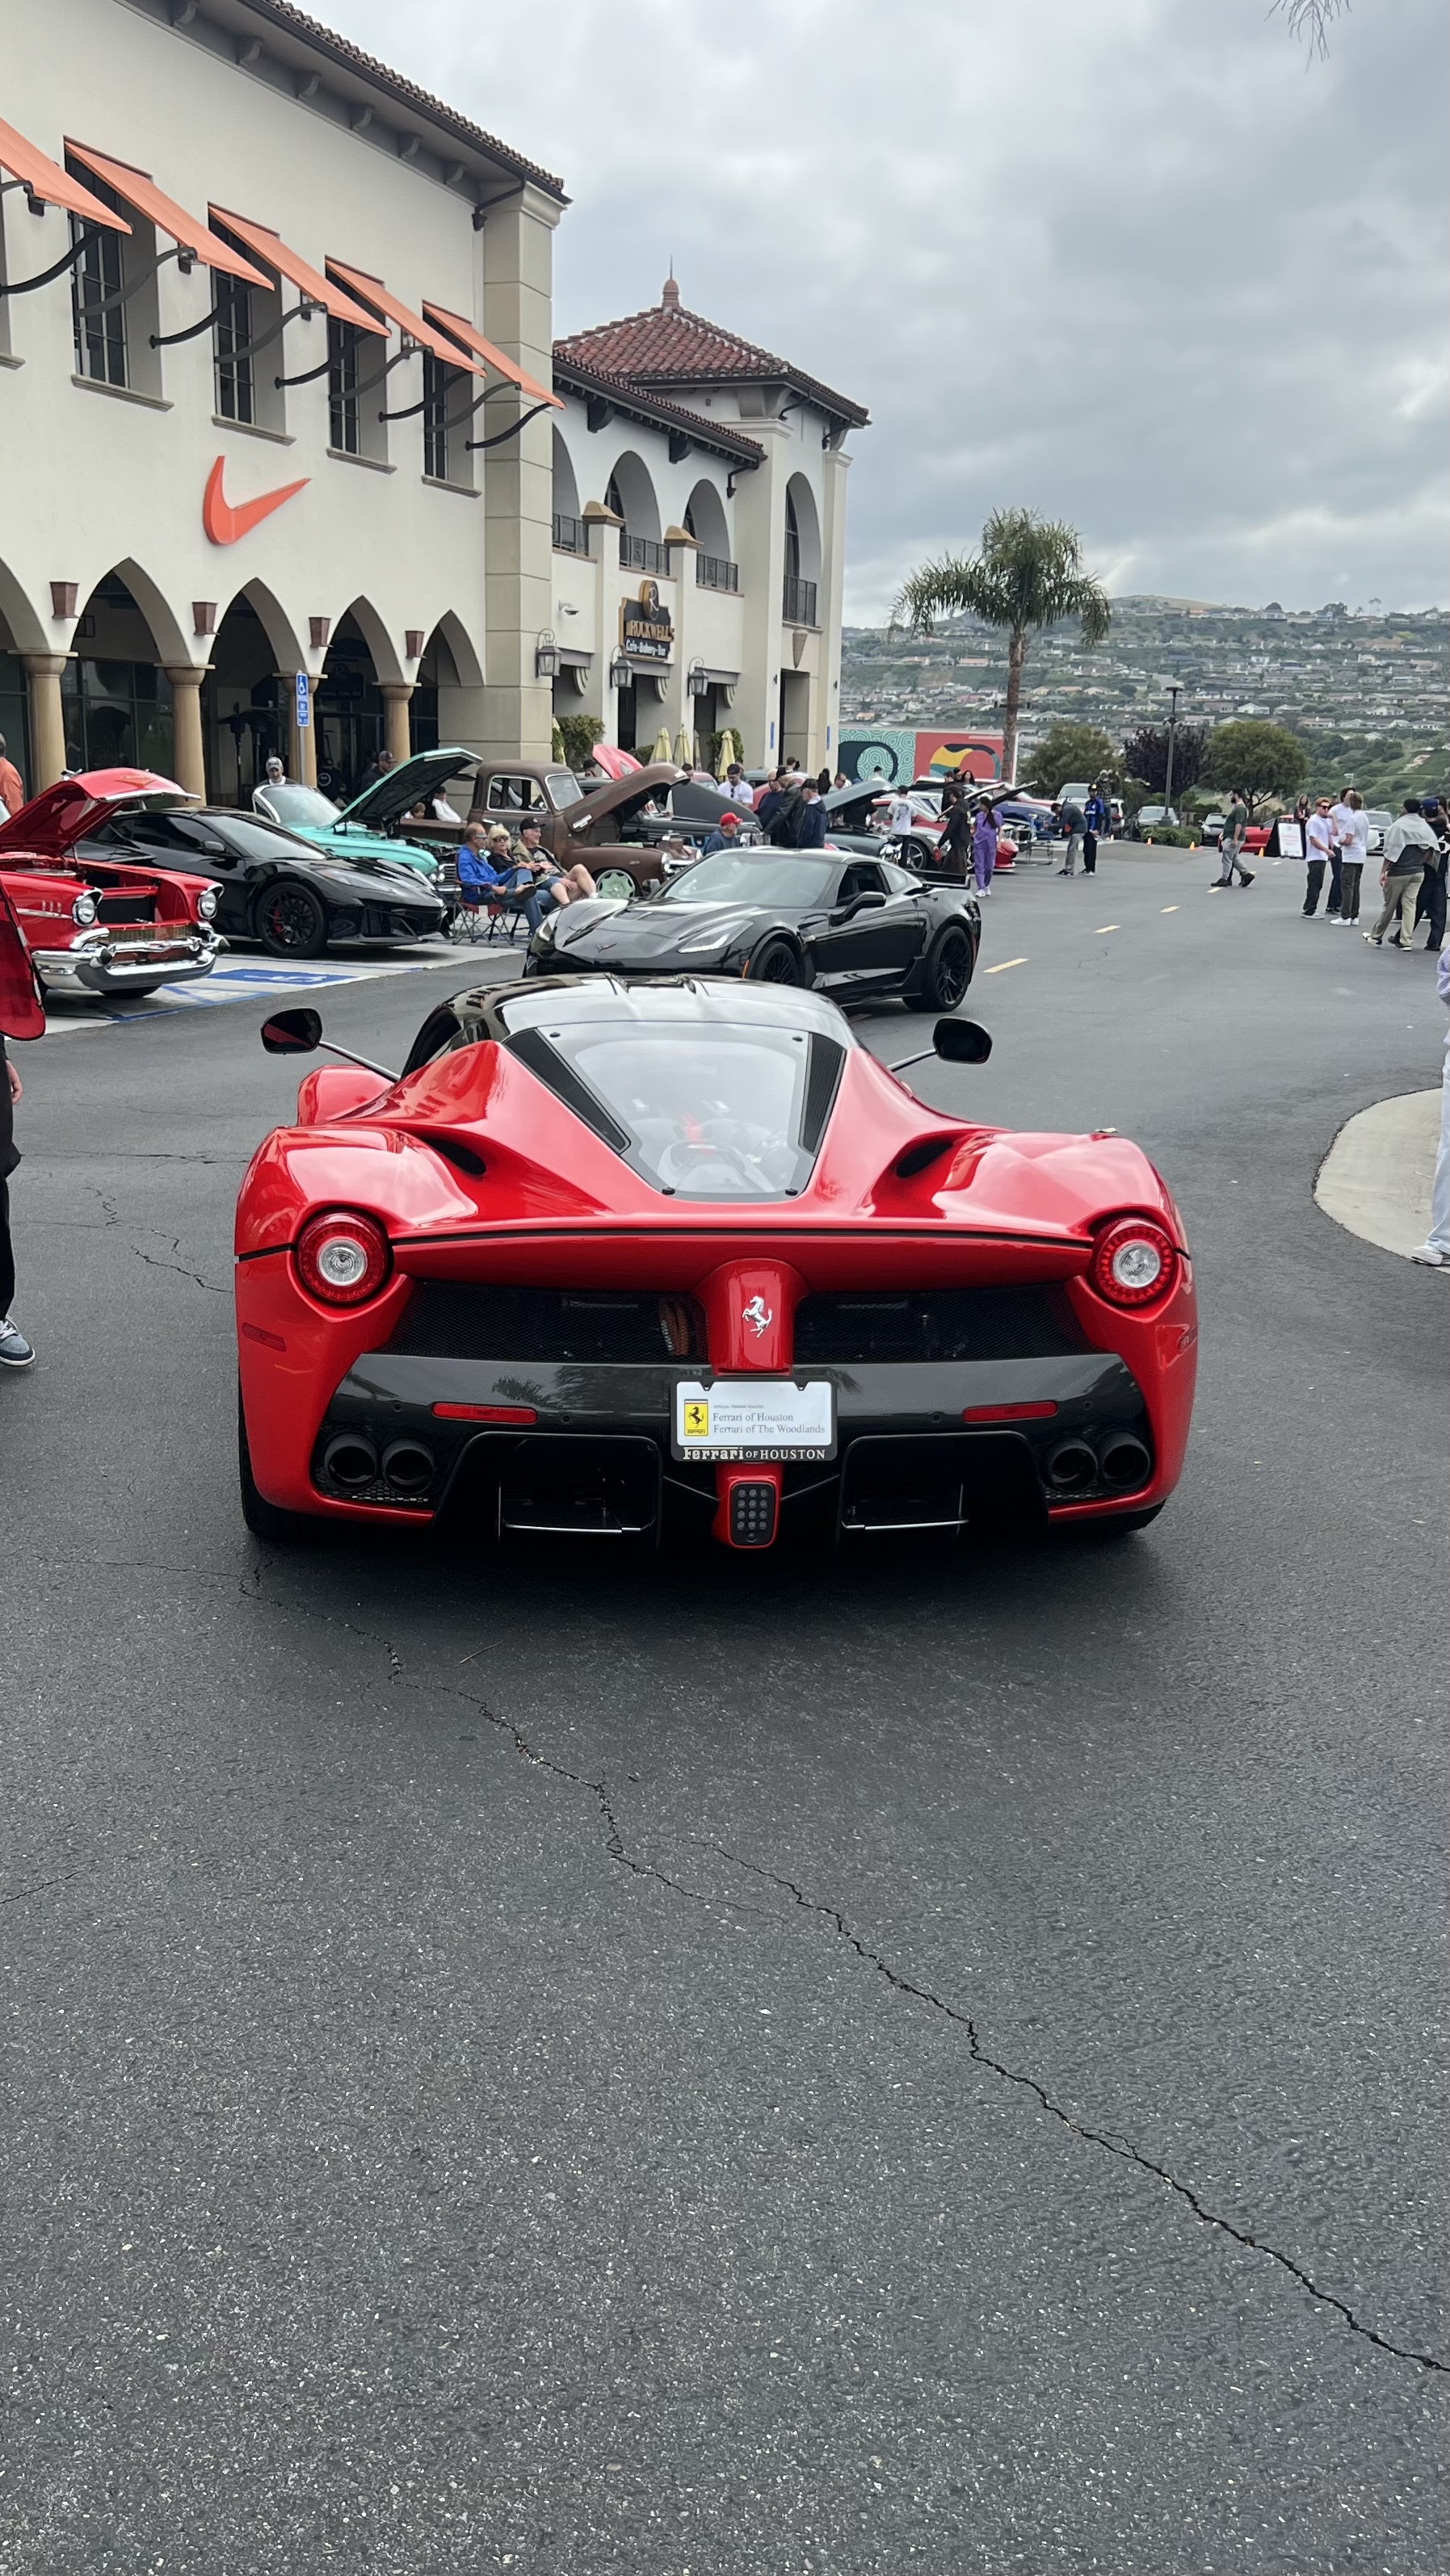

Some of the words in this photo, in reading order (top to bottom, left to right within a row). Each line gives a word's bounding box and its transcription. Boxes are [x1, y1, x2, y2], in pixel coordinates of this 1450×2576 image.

[713, 1413, 742, 1421] Ferrari
[745, 1413, 755, 1421] of
[757, 1413, 793, 1421] Houston
[713, 1424, 743, 1433] Ferrari
[746, 1424, 756, 1433] of
[757, 1425, 774, 1433] The
[777, 1424, 825, 1433] Woodlands
[683, 1447, 743, 1460] Ferrari
[760, 1449, 826, 1460] HOUSTON
